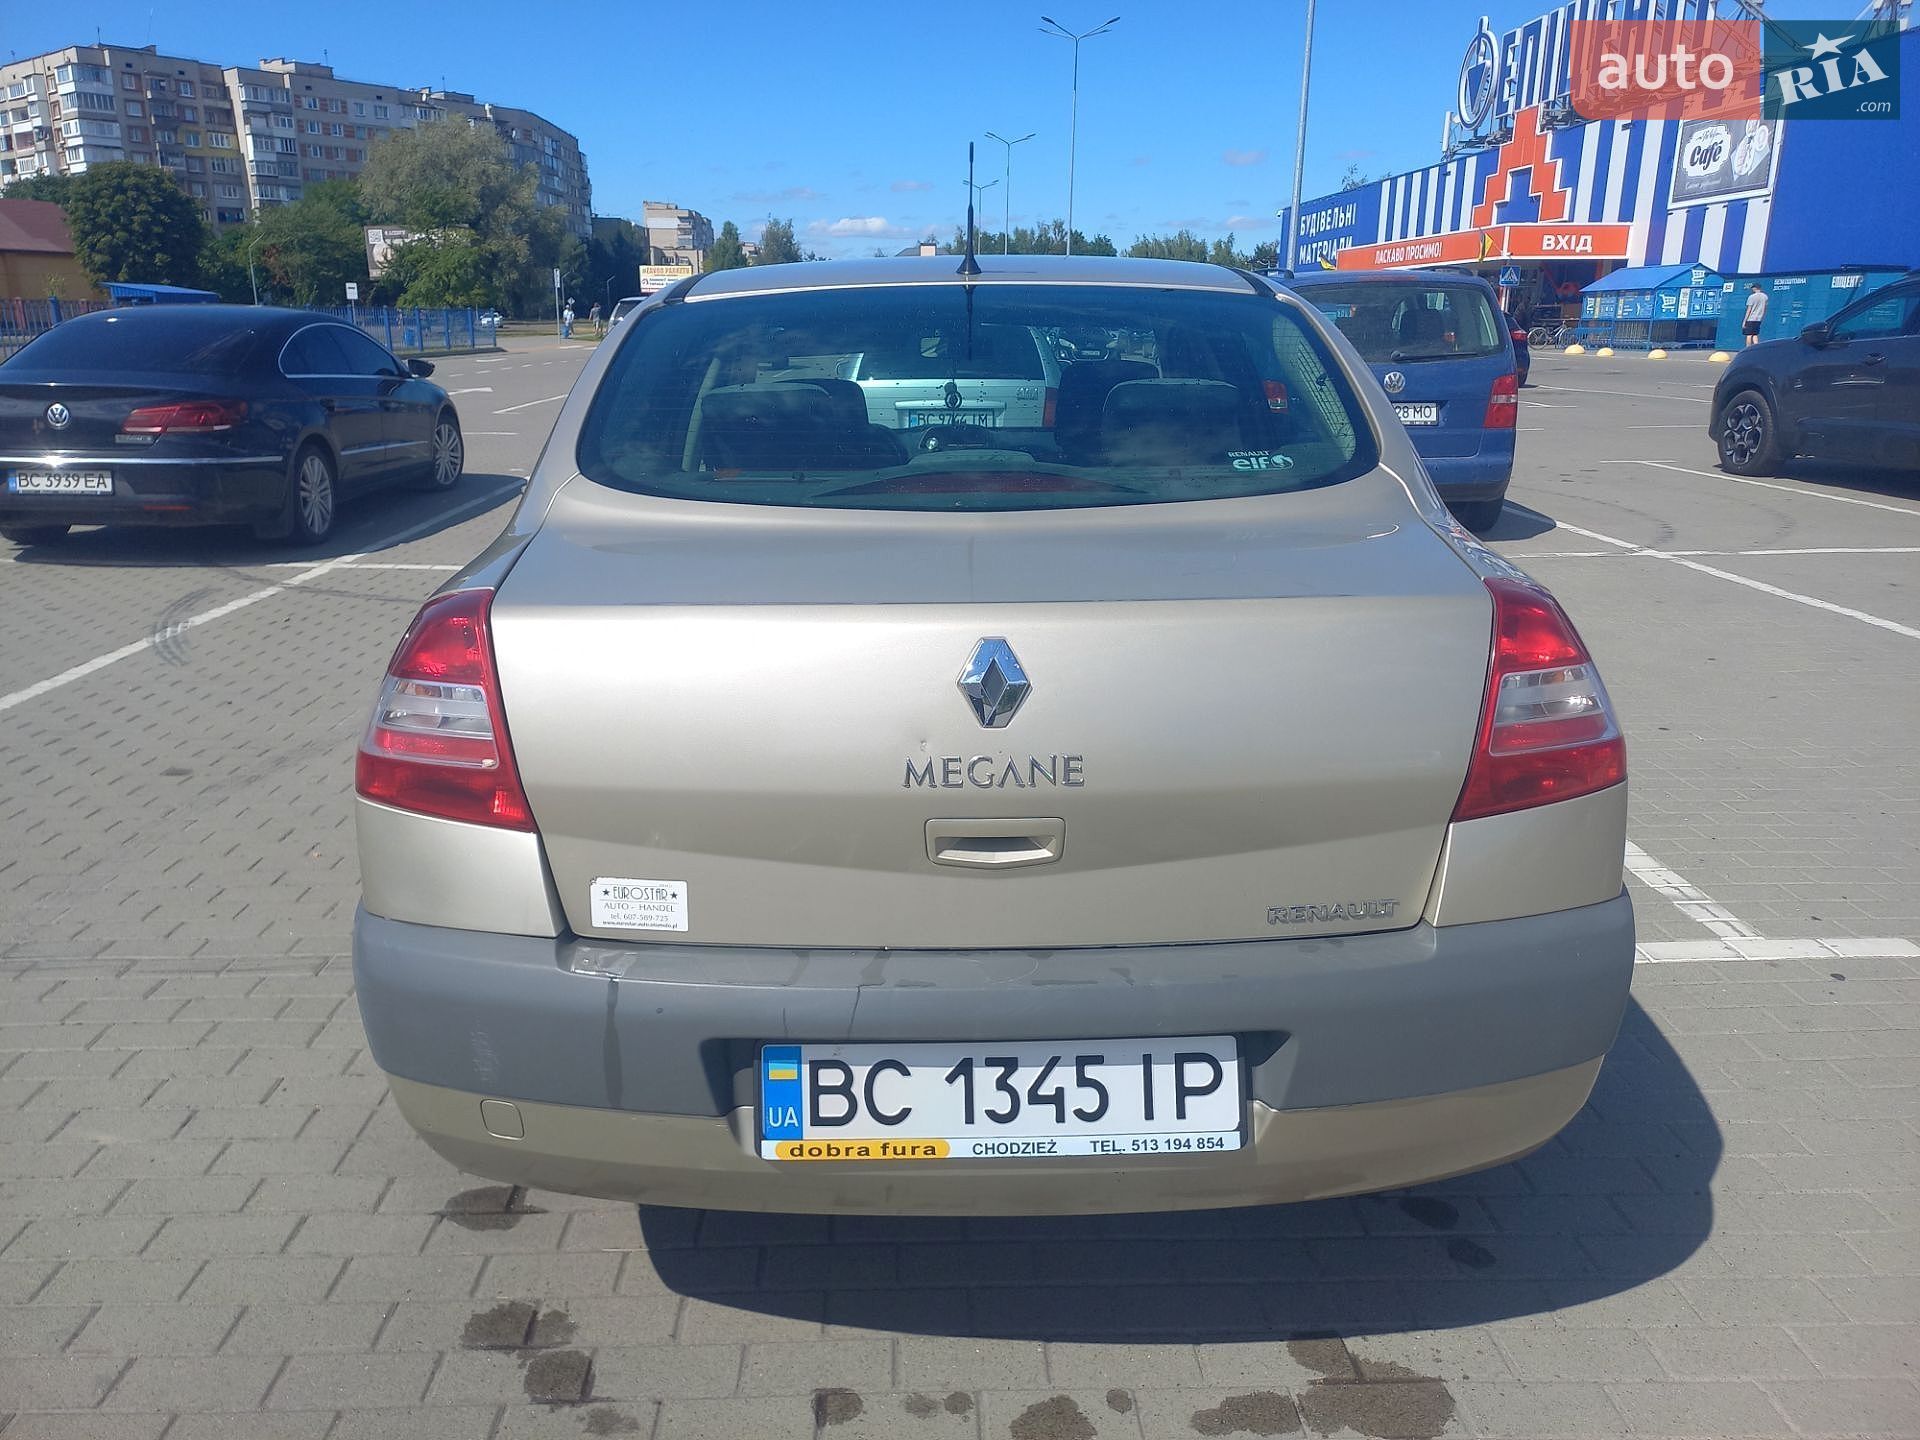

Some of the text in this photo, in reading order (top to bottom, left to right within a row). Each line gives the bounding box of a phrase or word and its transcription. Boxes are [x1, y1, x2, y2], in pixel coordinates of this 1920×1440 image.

[1689, 139, 1724, 171] Café
[1300, 202, 1357, 238] БУДІВЕЛЬНІ
[1375, 241, 1443, 265] ЛАСКАВО ПРОСИМО!
[1541, 234, 1593, 253] ВХІД
[1413, 405, 1432, 419] MO
[1227, 450, 1270, 458] RENAULT
[1232, 457, 1270, 470] elf
[18, 473, 107, 489] BC 3939 EA
[902, 753, 1085, 788] MEGANE
[613, 886, 668, 901] EUROSTAR
[604, 902, 629, 910] AUTO
[639, 903, 676, 912] HANDEL
[1265, 898, 1400, 925] RENAULT
[808, 1052, 1223, 1127] BC 1345 IP
[768, 1106, 799, 1127] UA
[789, 1136, 1225, 1158] dobra fura CHODZIEŻ TEL. 513 194 854
